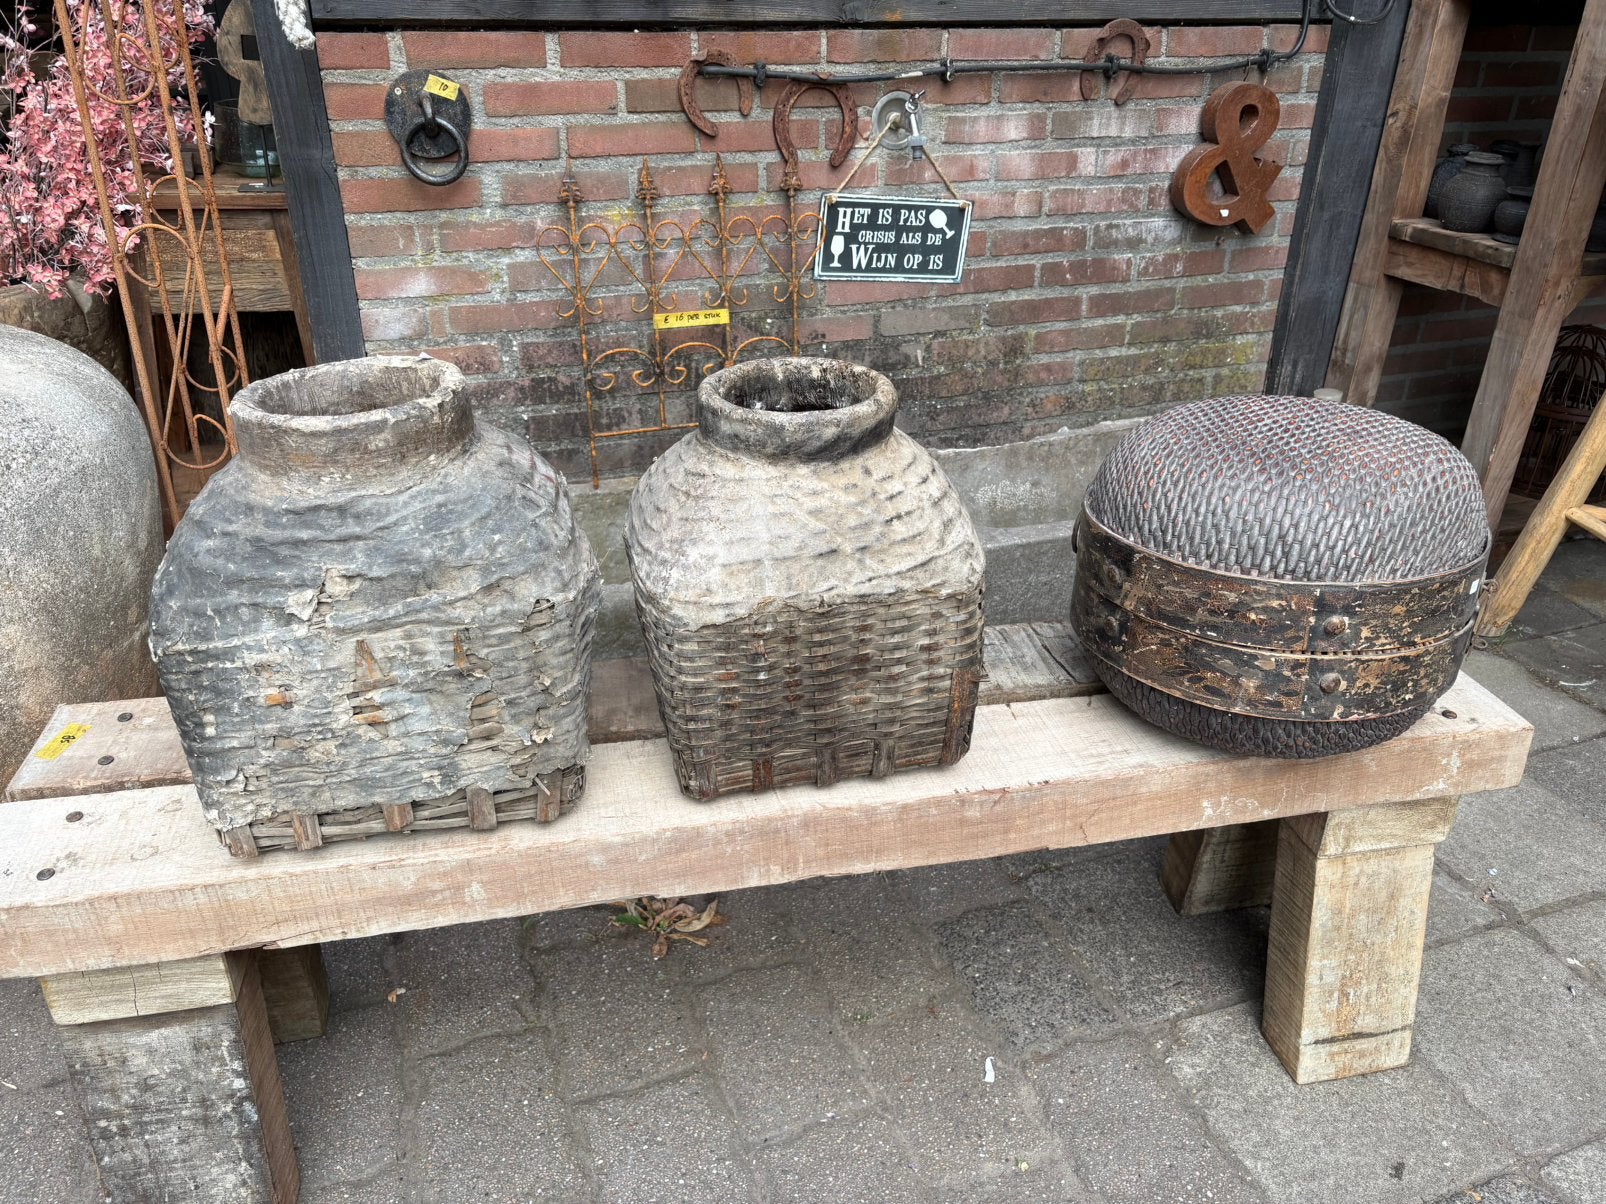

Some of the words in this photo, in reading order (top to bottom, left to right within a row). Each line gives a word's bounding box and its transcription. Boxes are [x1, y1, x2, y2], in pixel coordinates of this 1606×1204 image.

[438, 82, 449, 92] 10
[1170, 80, 1285, 235] &
[835, 207, 871, 233] HET
[877, 207, 893, 225] IS
[899, 209, 927, 226] PAS
[858, 230, 896, 244] CRISIS
[900, 232, 922, 245] ALS
[926, 233, 943, 245] DE
[849, 244, 898, 270] WIJN
[903, 254, 923, 269] OP
[928, 254, 944, 270] IS
